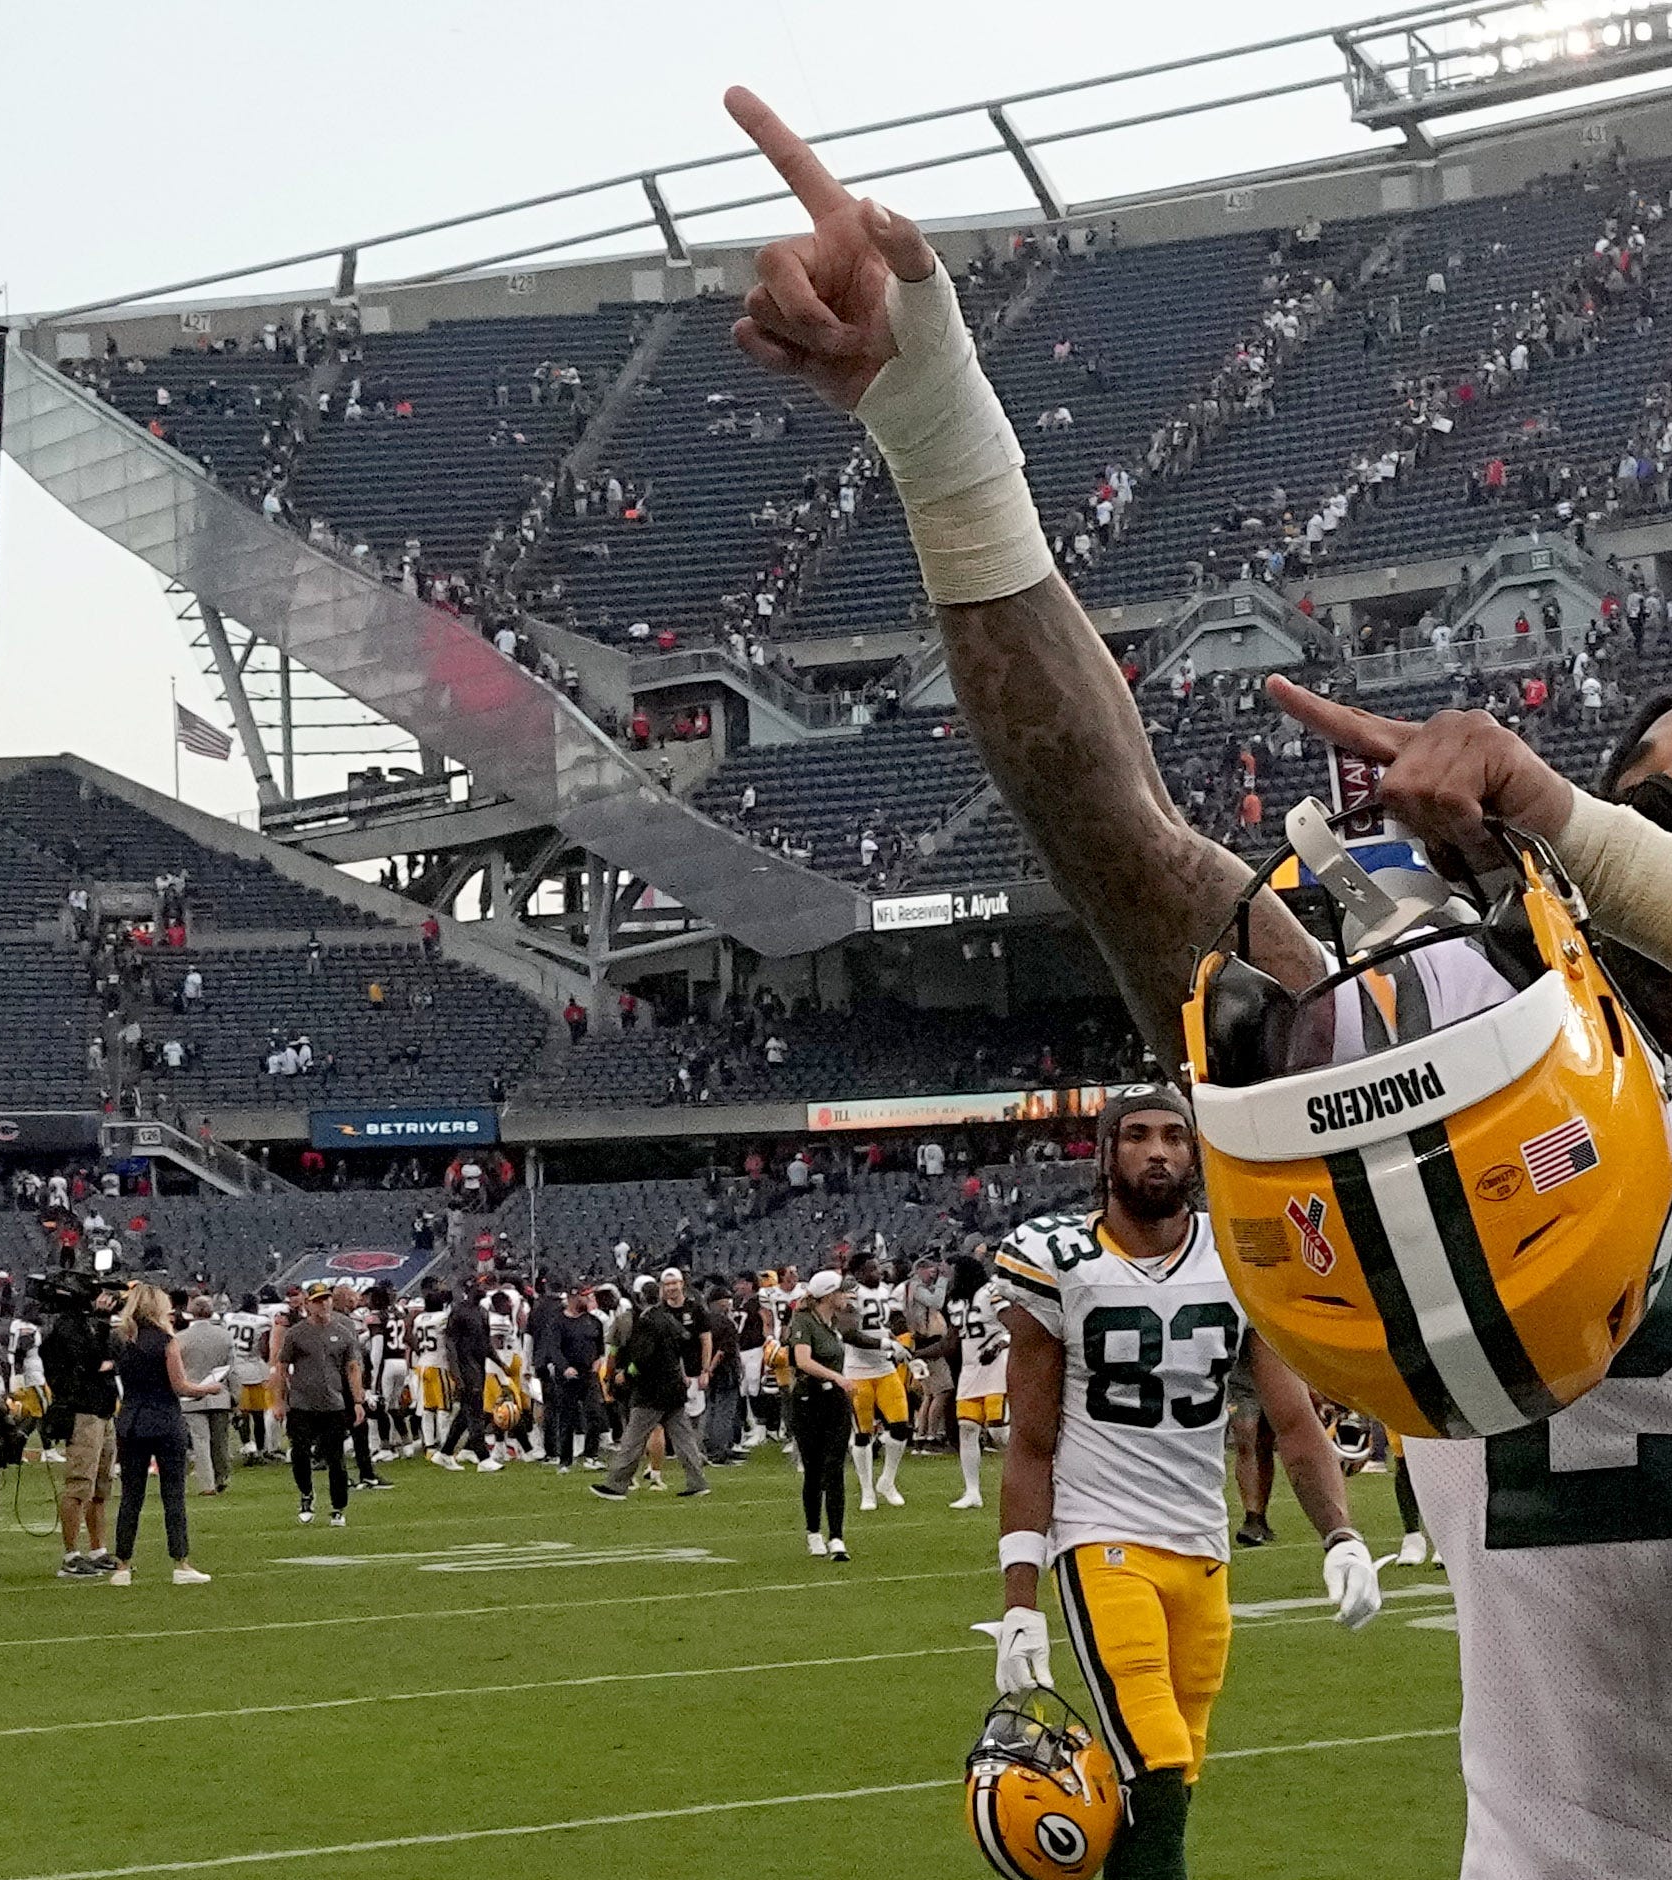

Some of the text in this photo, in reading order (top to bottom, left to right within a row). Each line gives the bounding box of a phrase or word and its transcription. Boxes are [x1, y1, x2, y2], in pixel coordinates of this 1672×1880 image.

[876, 892, 1009, 924] NFL Receiving 3. Aiyuk
[1307, 1061, 1446, 1136] PACKERS
[365, 1120, 479, 1135] BETRIVERS
[386, 1319, 406, 1350] 32
[1083, 1302, 1240, 1429] 83
